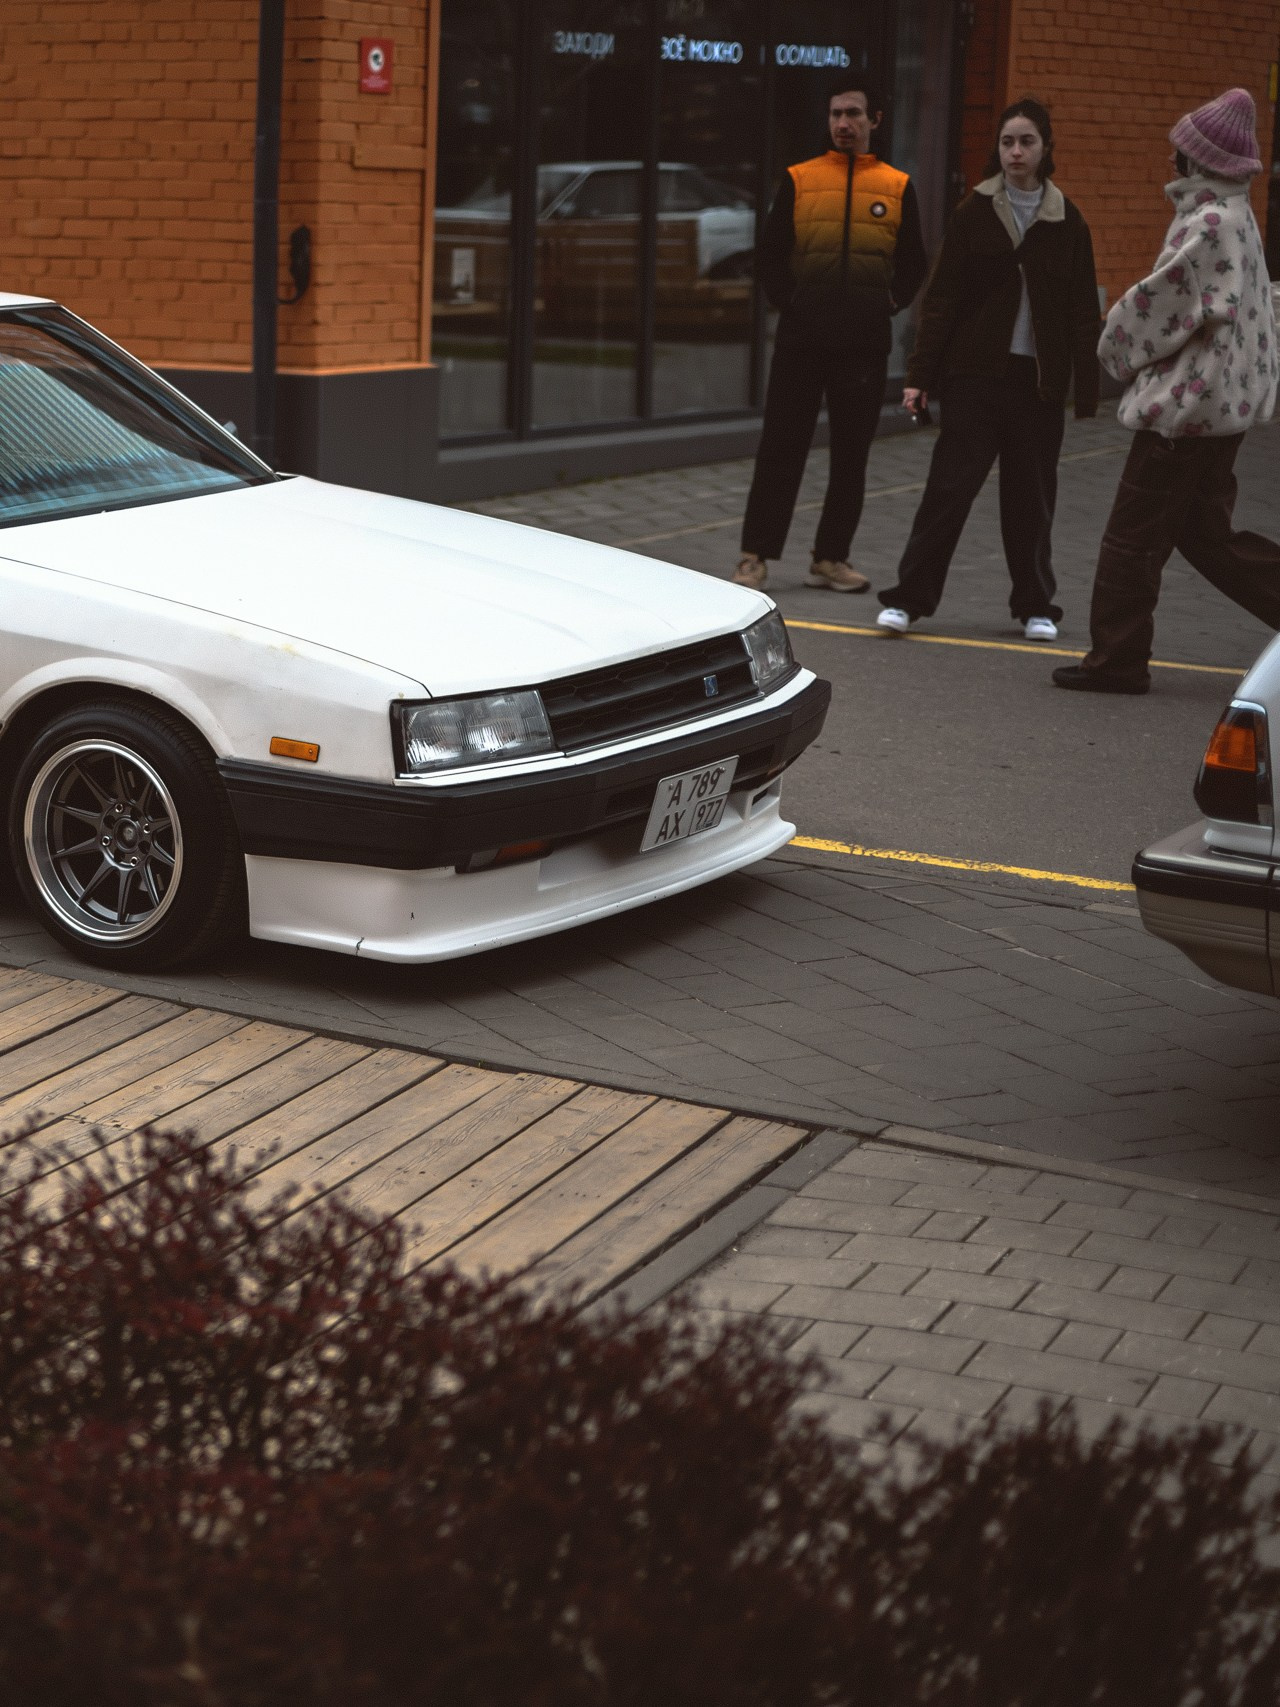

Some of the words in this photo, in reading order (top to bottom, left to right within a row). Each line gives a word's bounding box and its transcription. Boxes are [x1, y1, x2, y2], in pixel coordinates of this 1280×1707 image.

[553, 30, 615, 60] ЗАХОДИ
[687, 39, 744, 65] МОЖНО
[687, 767, 725, 802] 789
[655, 809, 686, 844] АХ
[696, 798, 723, 826] 977
